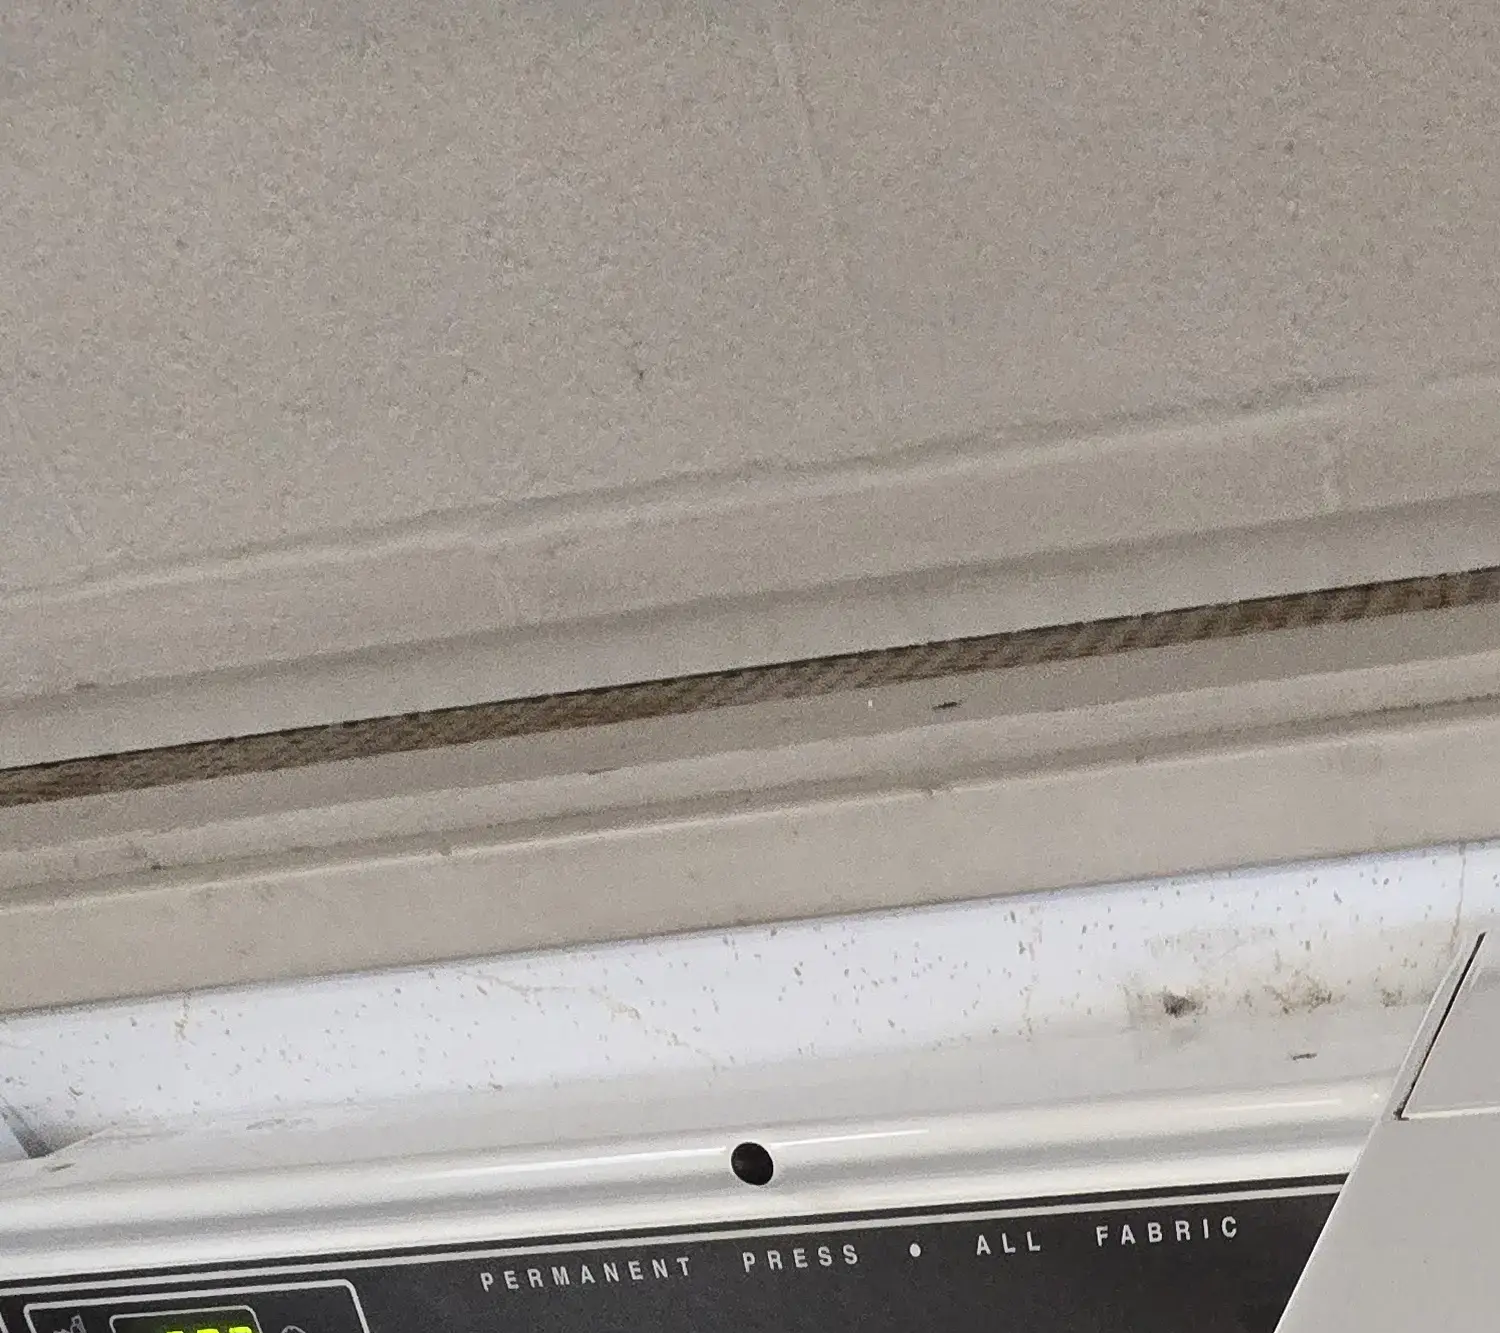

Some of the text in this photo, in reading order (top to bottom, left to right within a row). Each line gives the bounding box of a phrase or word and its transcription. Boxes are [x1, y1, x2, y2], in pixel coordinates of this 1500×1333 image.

[480, 1216, 1237, 1292] PERMANENT PRESS ALL FABRIC
